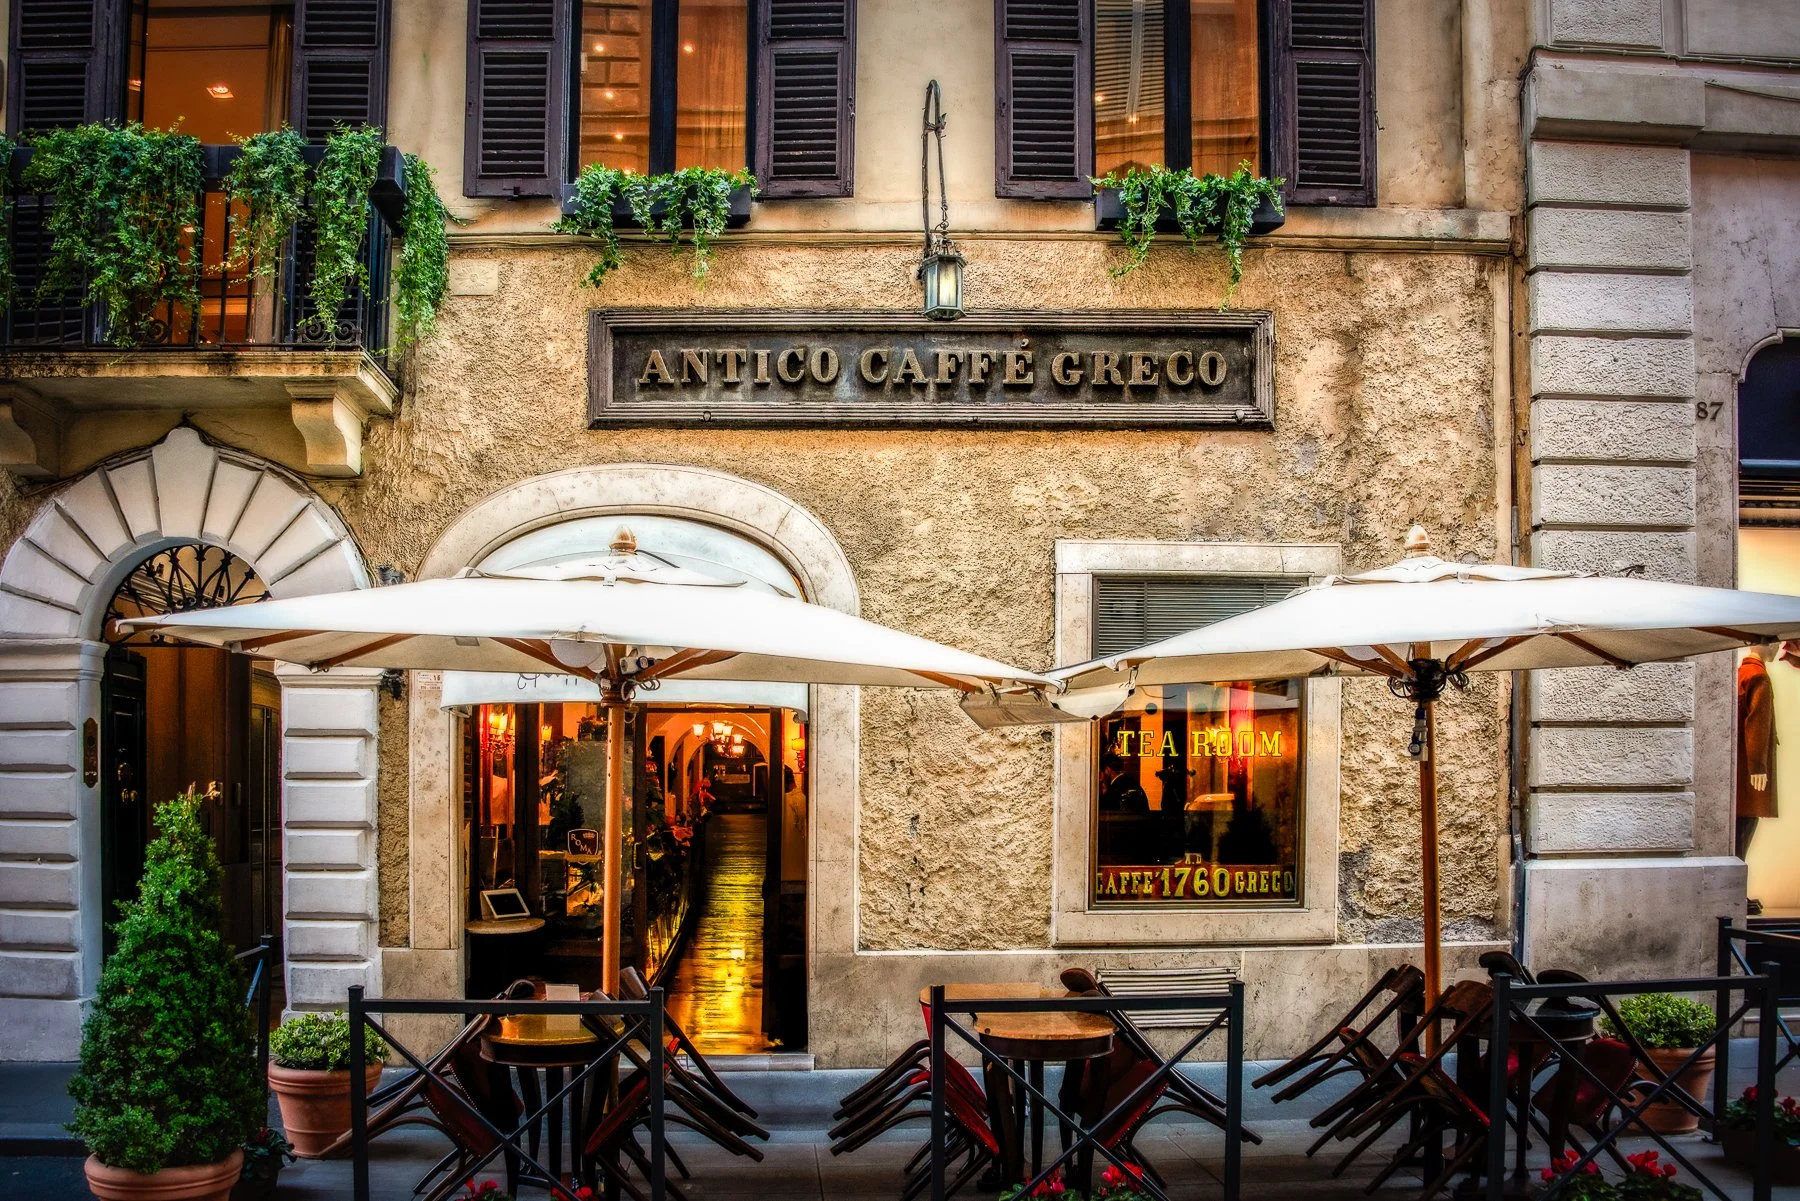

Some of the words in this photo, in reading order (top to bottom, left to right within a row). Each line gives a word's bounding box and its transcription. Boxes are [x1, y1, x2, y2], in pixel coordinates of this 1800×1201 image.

[638, 348, 839, 384] ANTICO
[1051, 350, 1227, 386] GRECO
[1696, 401, 1724, 421] 87
[1117, 730, 1179, 758] TEA
[1191, 730, 1282, 758] ROOM
[570, 833, 592, 855] ROMA
[1161, 867, 1230, 897] 1760
[1234, 870, 1294, 894] GRECO
